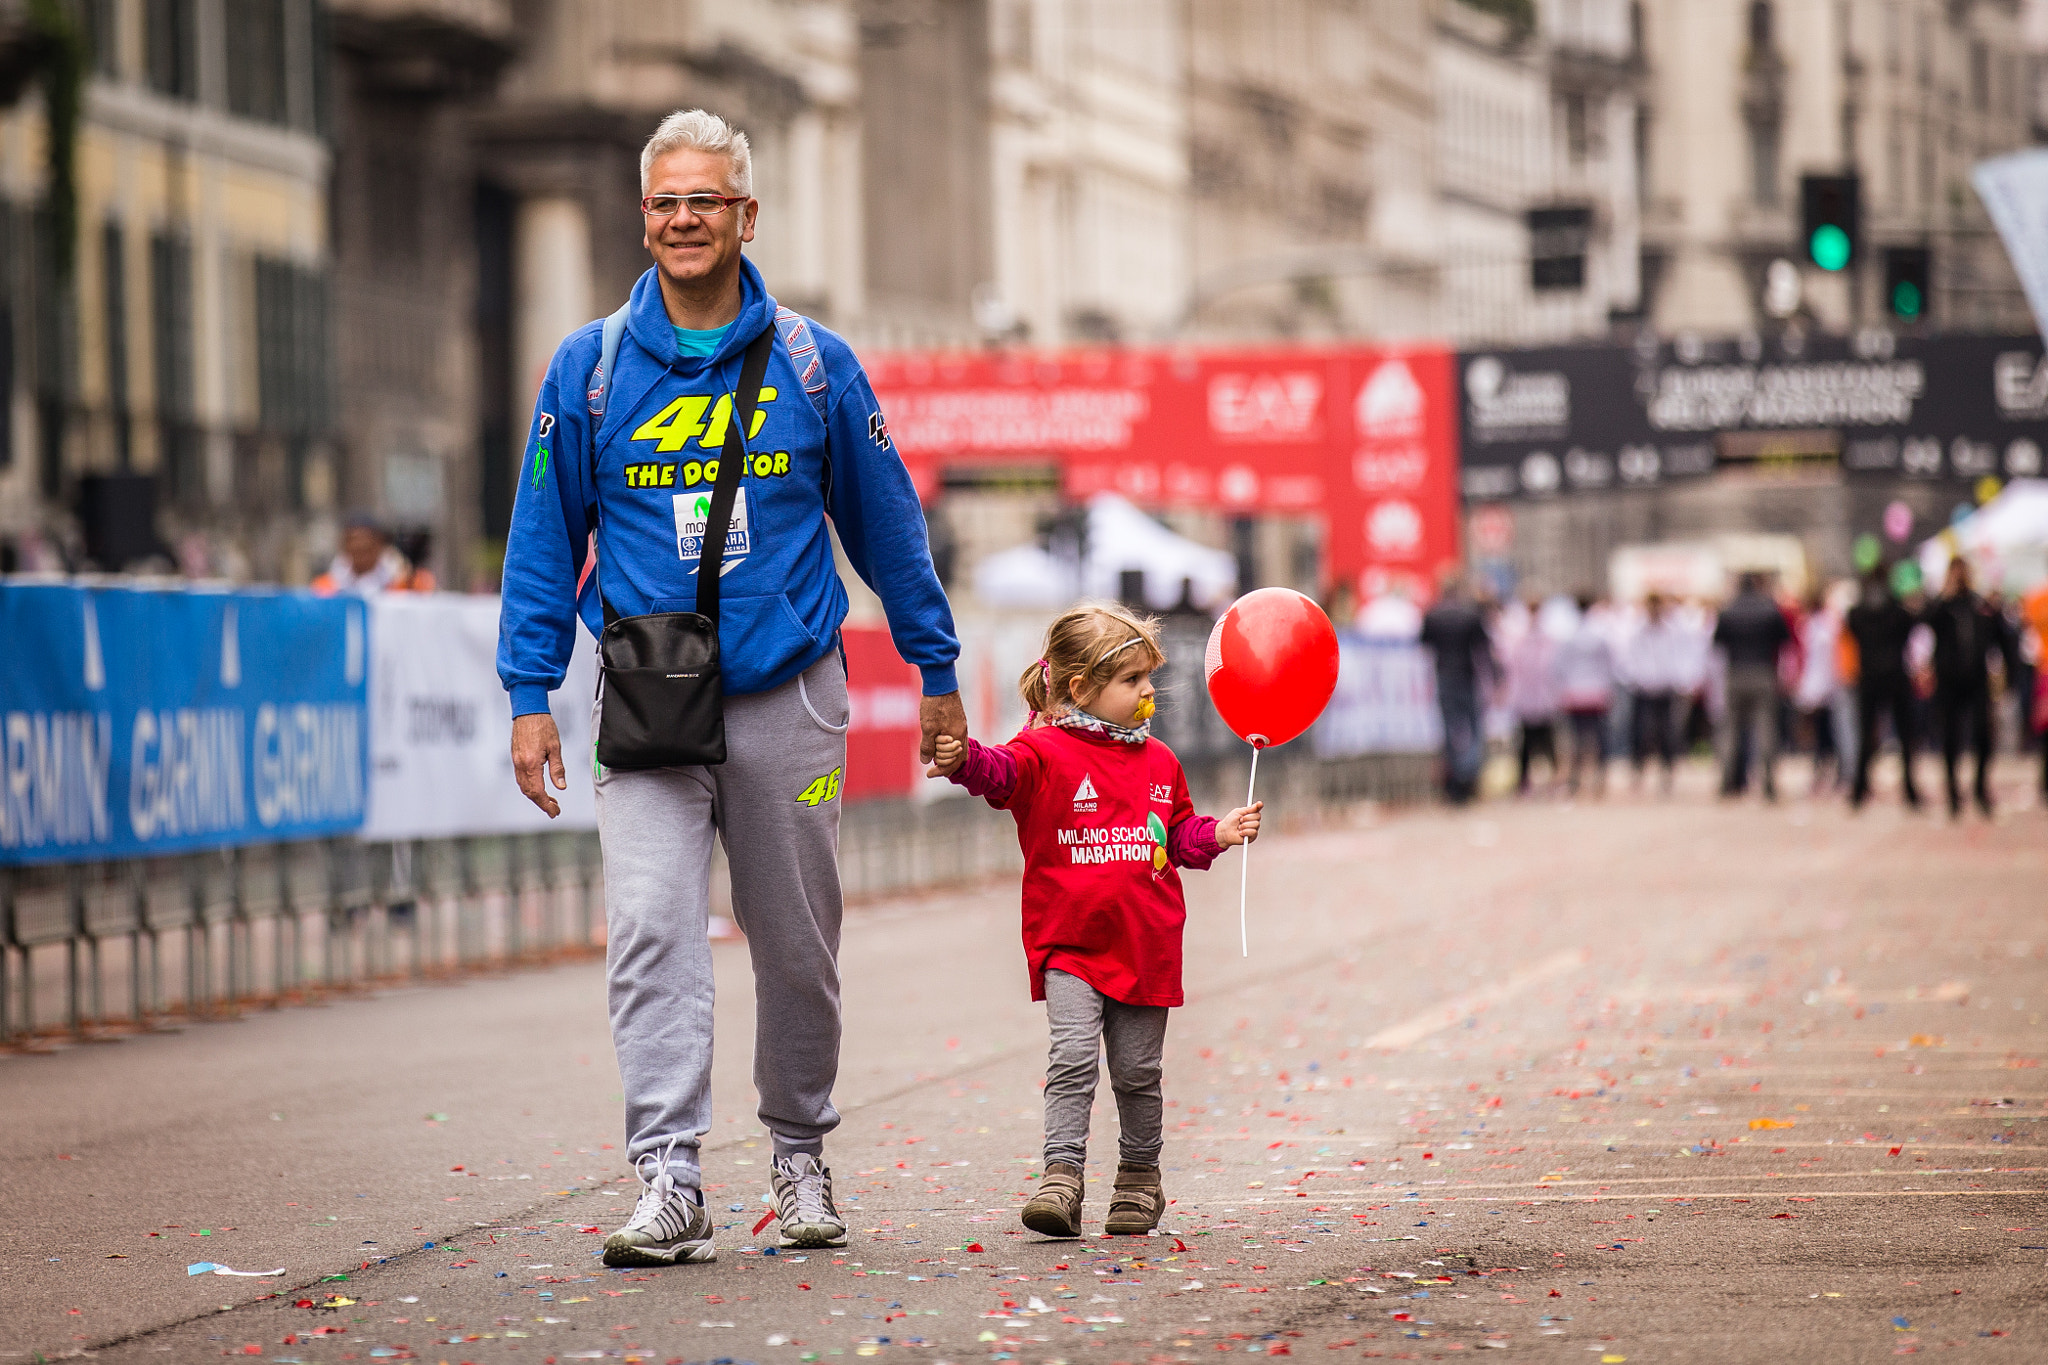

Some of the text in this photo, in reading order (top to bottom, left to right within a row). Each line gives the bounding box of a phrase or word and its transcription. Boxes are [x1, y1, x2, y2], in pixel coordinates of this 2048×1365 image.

[624, 450, 792, 490] THE DOTOR
[685, 518, 740, 534] moar
[795, 765, 841, 807] 46
[1057, 826, 1160, 845] MILANO SCHOOL
[1071, 844, 1151, 864] MARATHON
